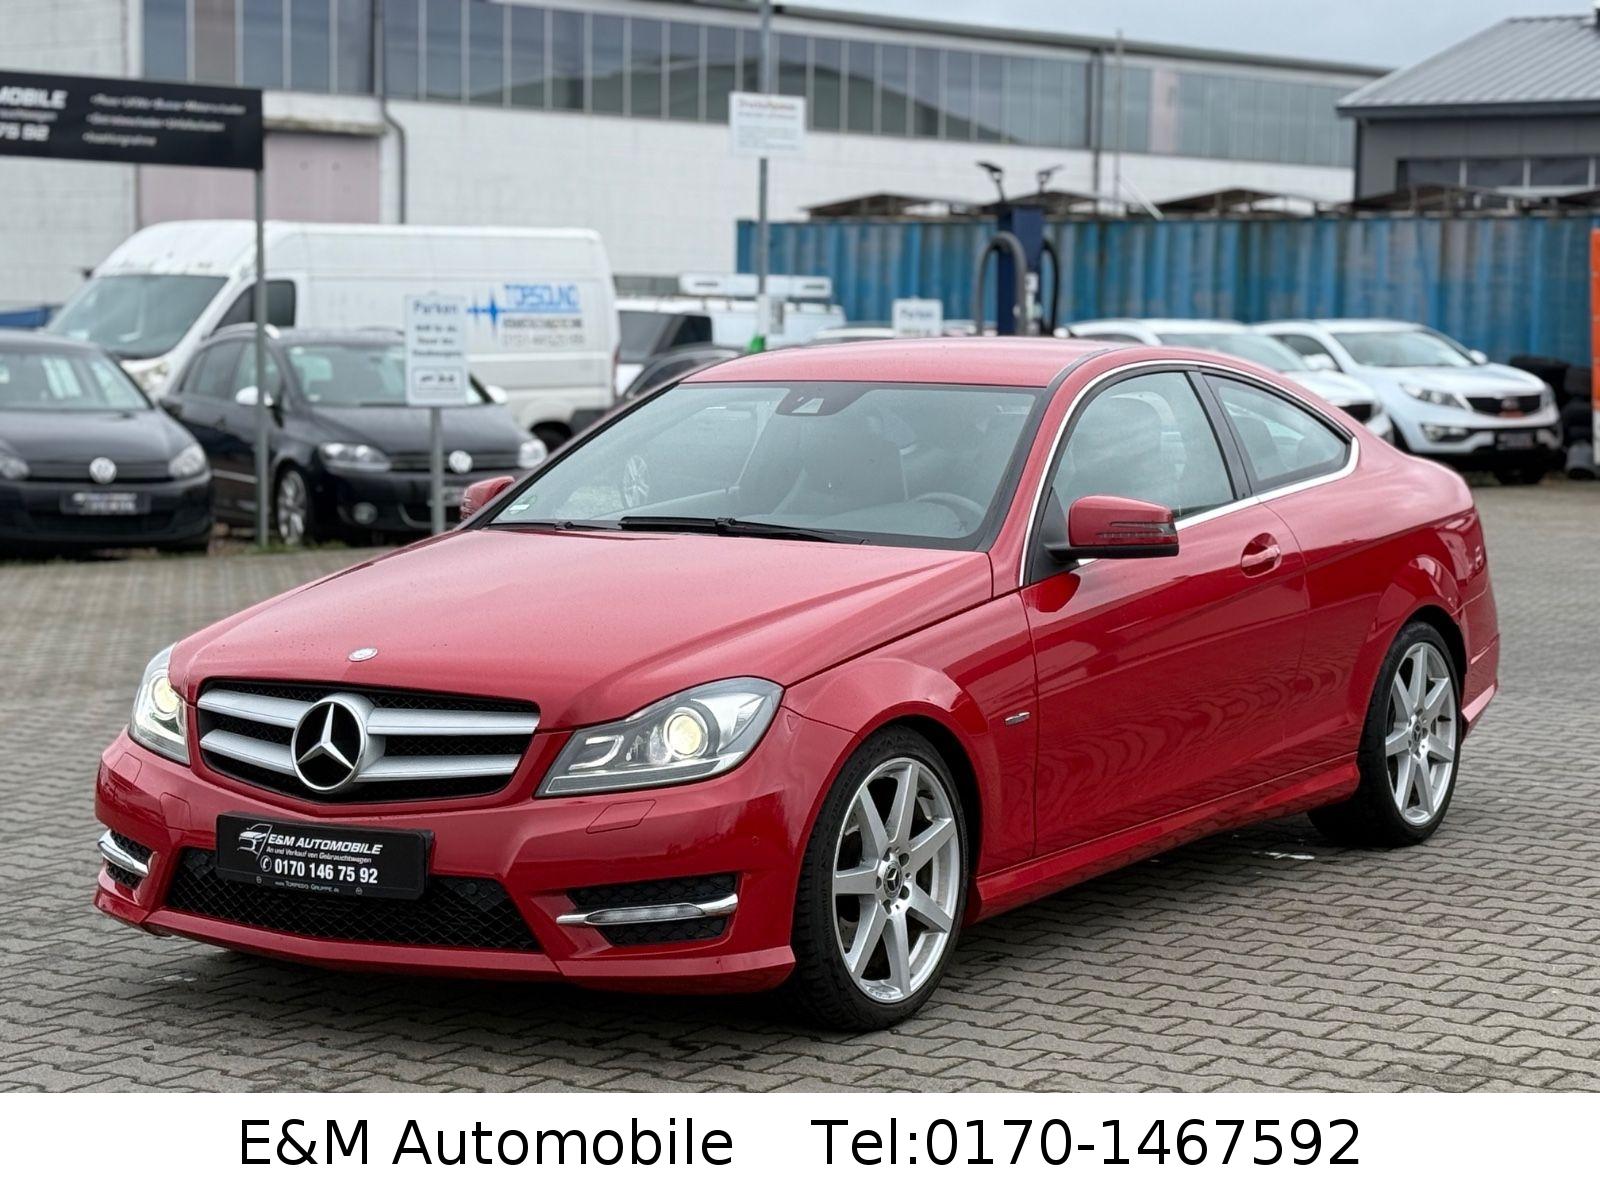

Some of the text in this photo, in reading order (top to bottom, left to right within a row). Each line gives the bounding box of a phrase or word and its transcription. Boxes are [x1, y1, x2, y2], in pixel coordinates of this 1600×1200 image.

[267, 833, 383, 855] E&M AUTOMOBILE
[274, 847, 285, 855] und
[285, 847, 307, 857] Verkauf
[307, 851, 318, 859] von
[318, 852, 372, 864] Gebrauchtwagen
[274, 858, 378, 884] 0170 146 75 92
